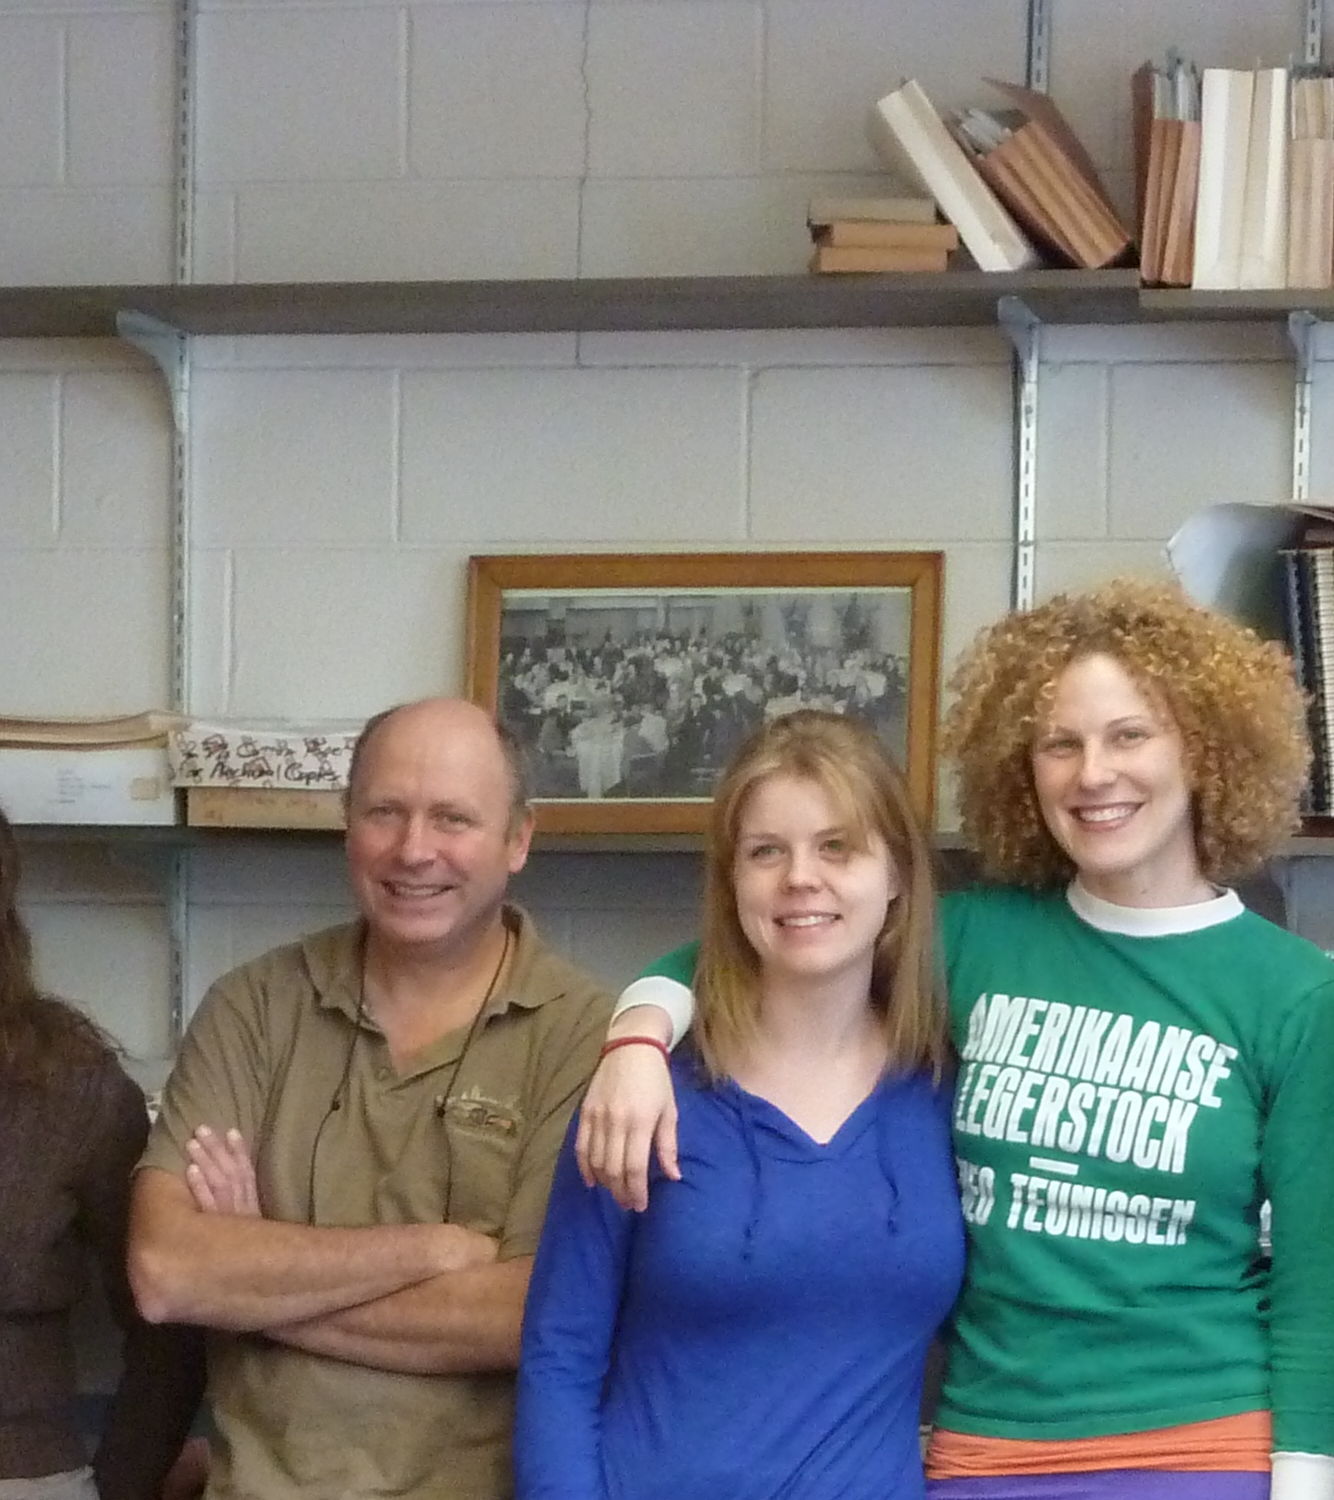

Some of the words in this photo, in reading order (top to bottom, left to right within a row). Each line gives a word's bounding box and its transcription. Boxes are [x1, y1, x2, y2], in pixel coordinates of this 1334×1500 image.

[962, 992, 1238, 1108] AMERIKAANSE
[956, 1062, 1198, 1174] LEGERSTOCK
[1007, 1173, 1196, 1246] TEUNISSEN
